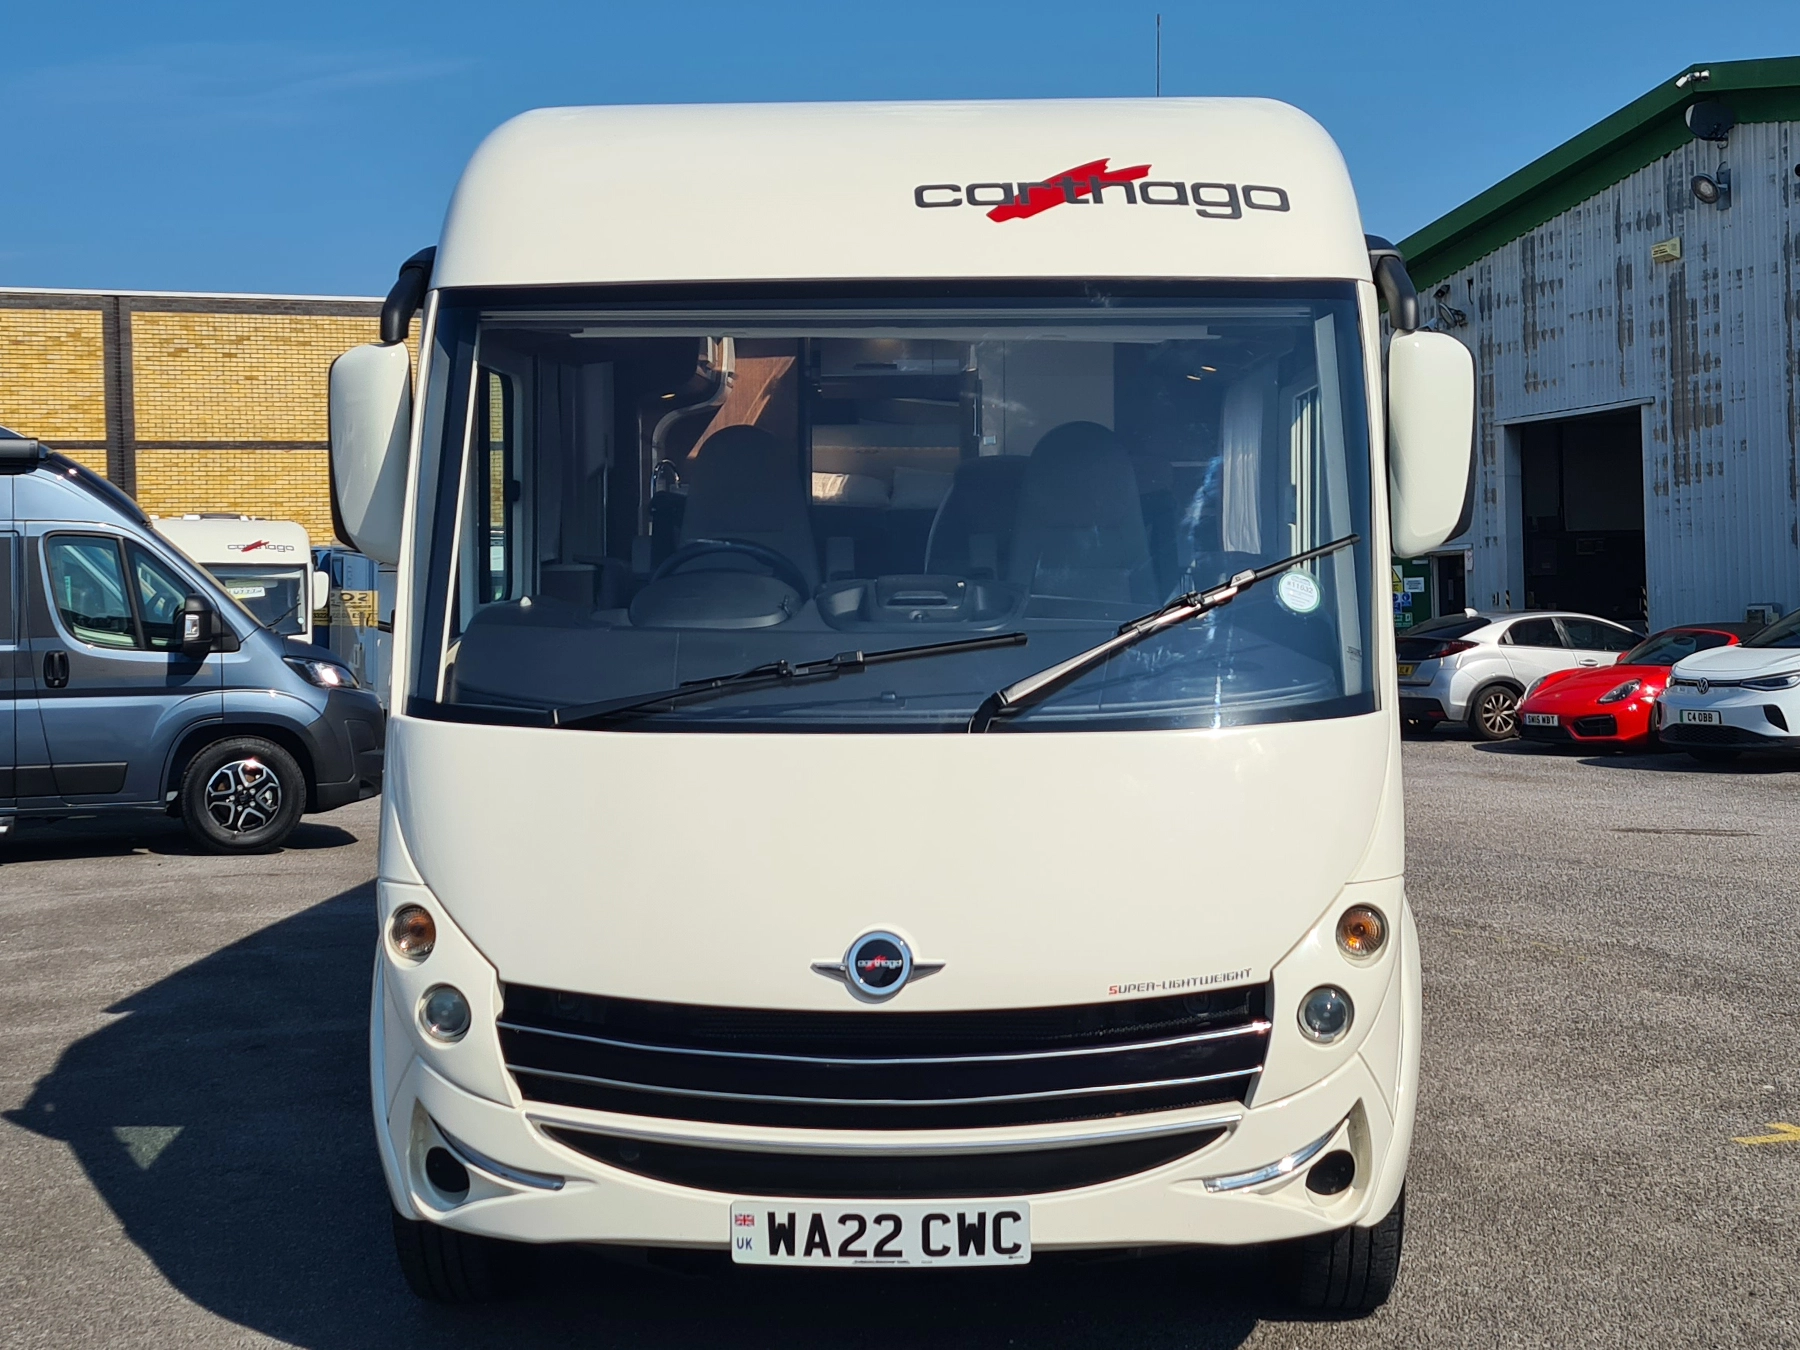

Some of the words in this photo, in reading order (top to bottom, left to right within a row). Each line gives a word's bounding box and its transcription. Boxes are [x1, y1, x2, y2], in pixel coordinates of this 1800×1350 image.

[914, 174, 1291, 220] carthago
[1687, 712, 1696, 722] C4
[857, 959, 902, 969] carthago
[1109, 968, 1252, 995] SUPER-LIGHTWEIGHT
[767, 1212, 903, 1257] WA22
[921, 1210, 1022, 1257] CWC
[737, 1237, 753, 1251] UK
